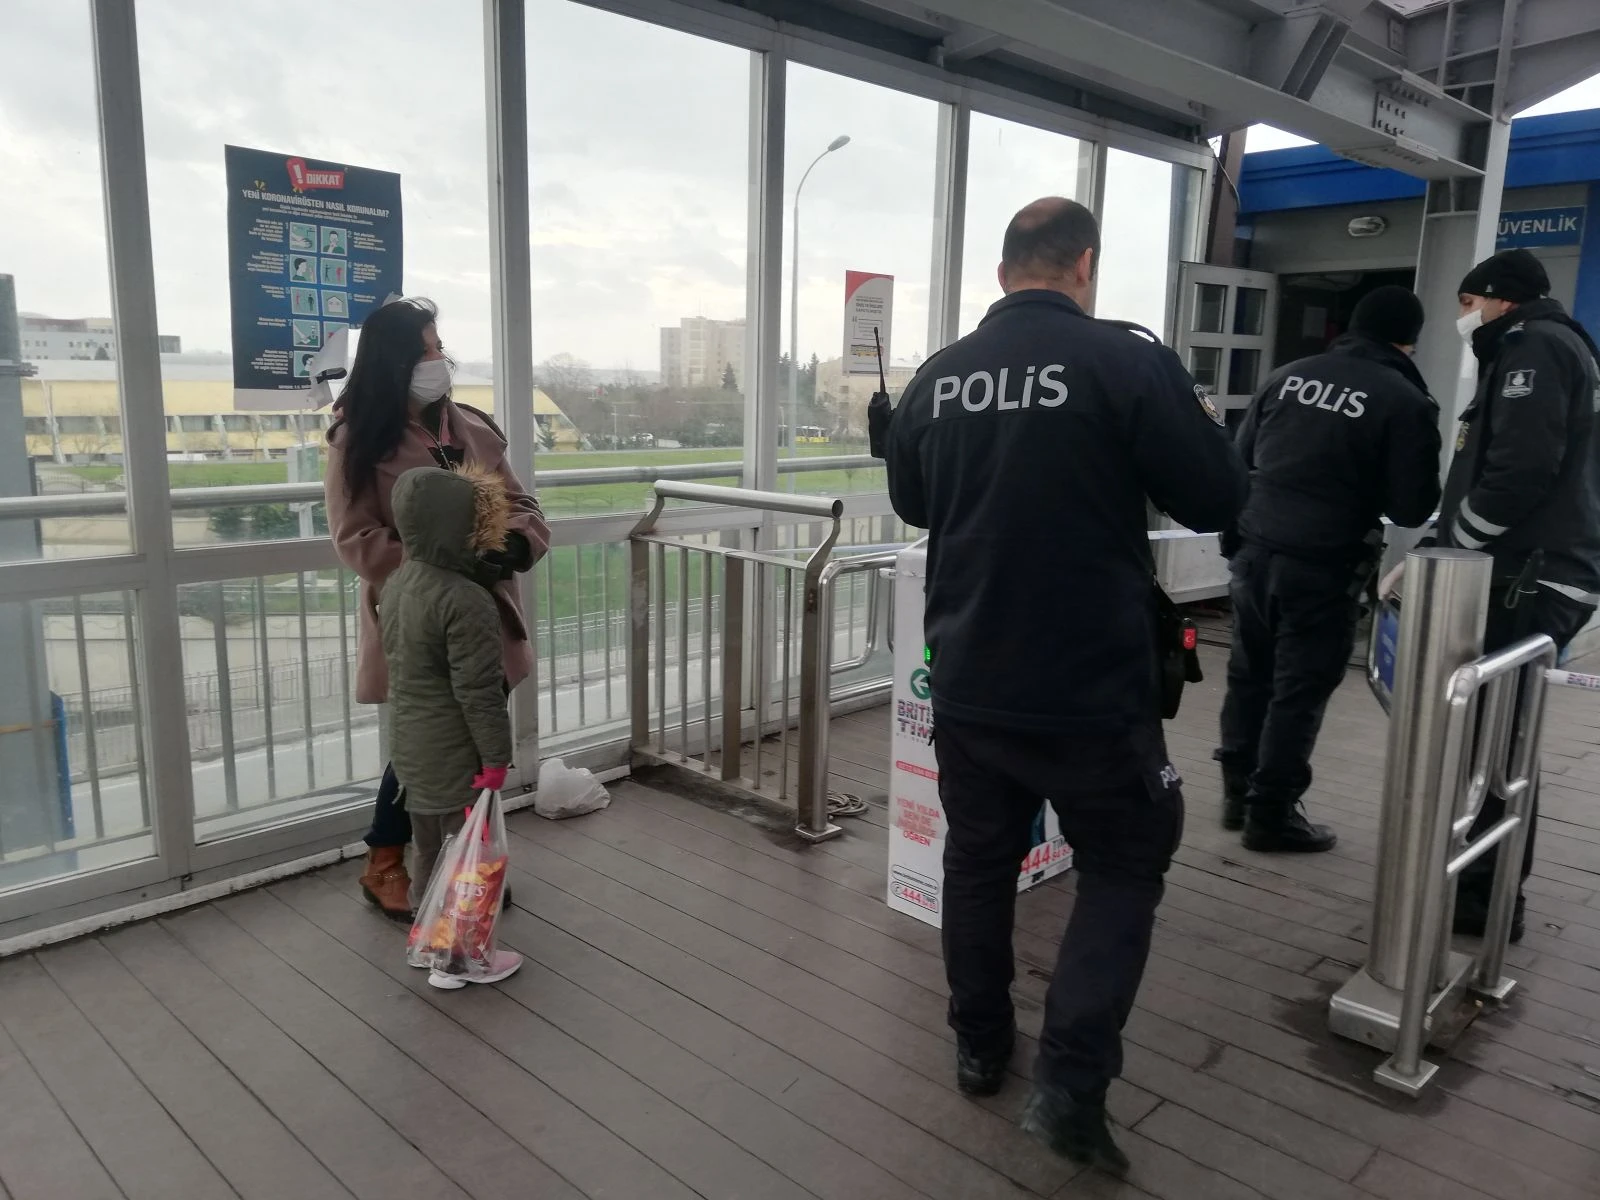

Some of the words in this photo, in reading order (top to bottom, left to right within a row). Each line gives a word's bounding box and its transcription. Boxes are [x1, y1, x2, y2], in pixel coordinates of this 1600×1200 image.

[305, 172, 341, 186] DİKKAT
[242, 189, 260, 200] YENİ
[261, 191, 325, 209] KORONAVİRÜSTEN
[325, 201, 346, 212] NASIL
[347, 204, 390, 218] KORUNALIM?
[1497, 214, 1578, 236] ÜVENLİK
[1020, 844, 1051, 874] 444
